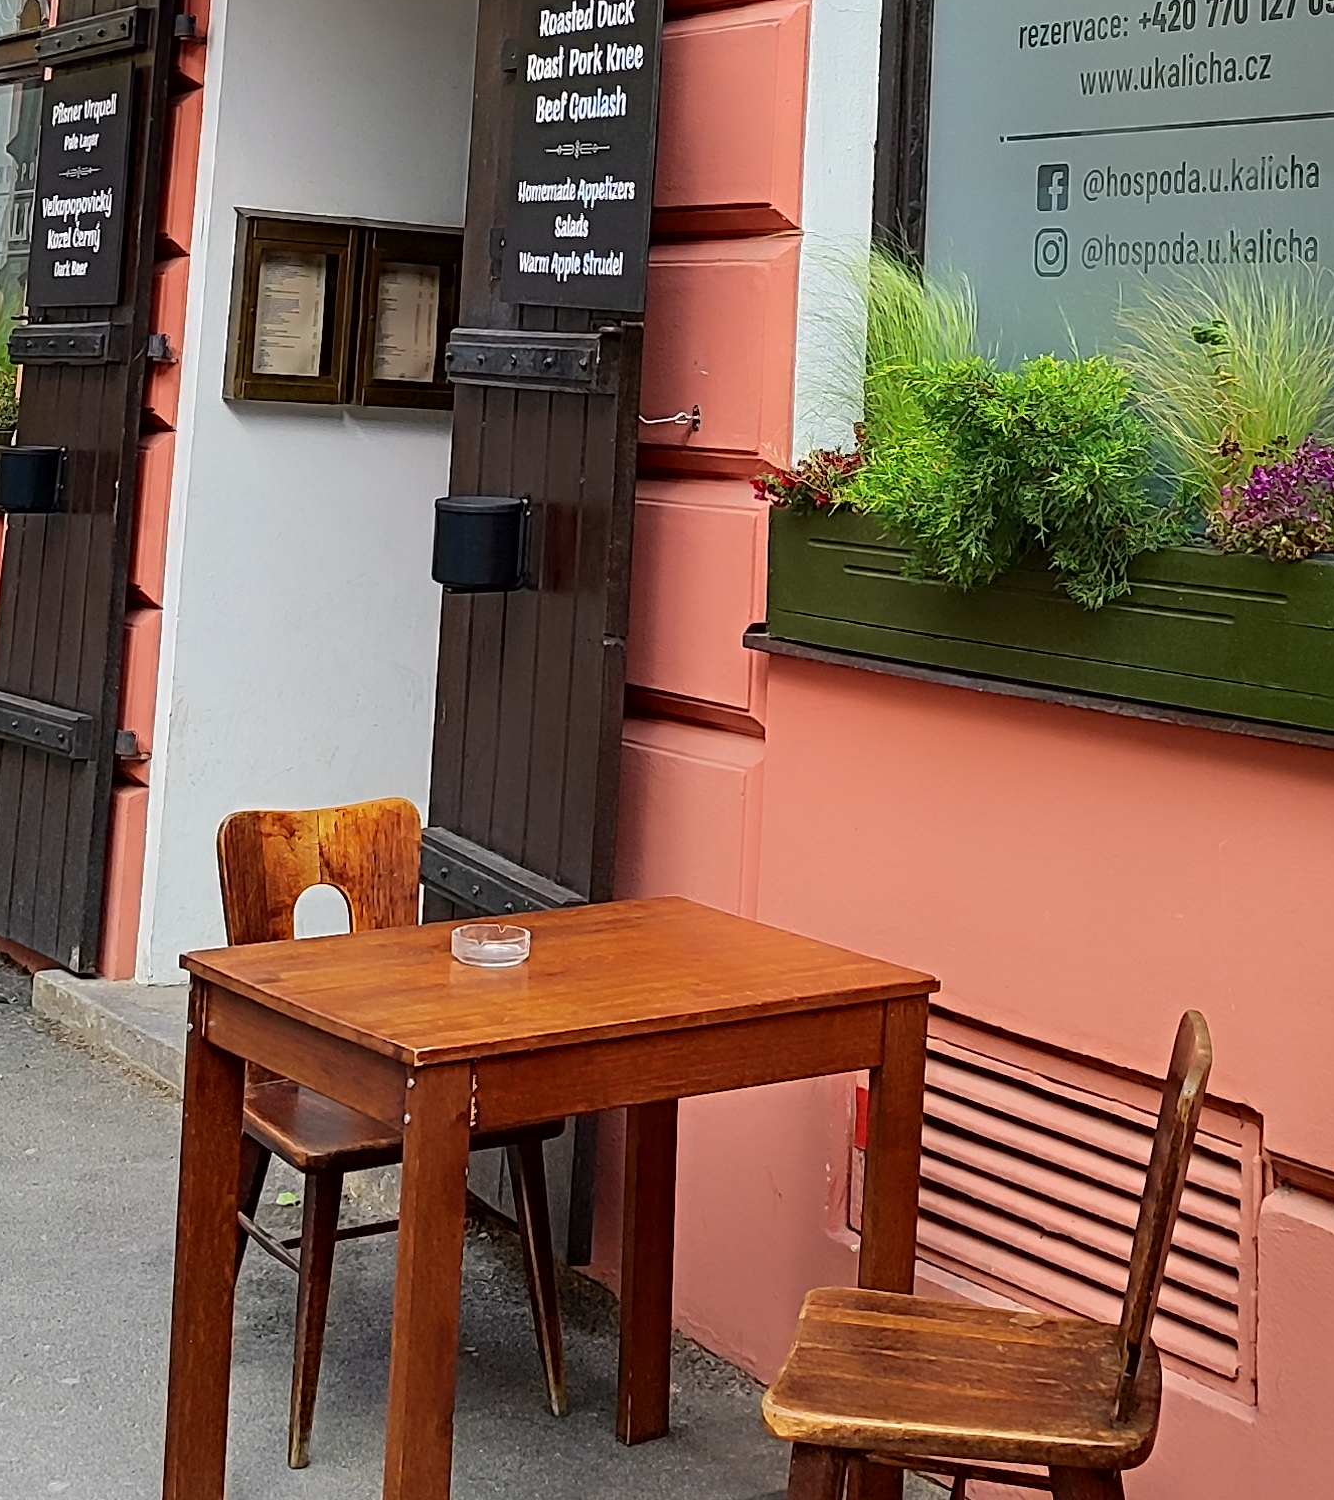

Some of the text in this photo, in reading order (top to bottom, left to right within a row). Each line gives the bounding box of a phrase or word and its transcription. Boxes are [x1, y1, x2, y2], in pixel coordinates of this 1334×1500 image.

[539, 0, 595, 39] Roasted
[1019, 13, 1129, 49] rezervace:
[526, 42, 644, 82] Roast Pork Knee
[1080, 51, 1272, 95] www.ukalicha.cz
[52, 93, 117, 127] Pilsner Urquell
[535, 84, 627, 124] Beef Goulash
[517, 174, 635, 211] Homemade Appetizers
[1082, 154, 1320, 204] @hospoda.u.kalicha
[41, 187, 114, 223] Velkopopovický
[47, 220, 101, 253] Kozel Černý
[554, 212, 590, 239] Salads
[518, 249, 624, 282] Warm Apple Strudel
[1081, 227, 1318, 274] @hospoda.u.kalicha
